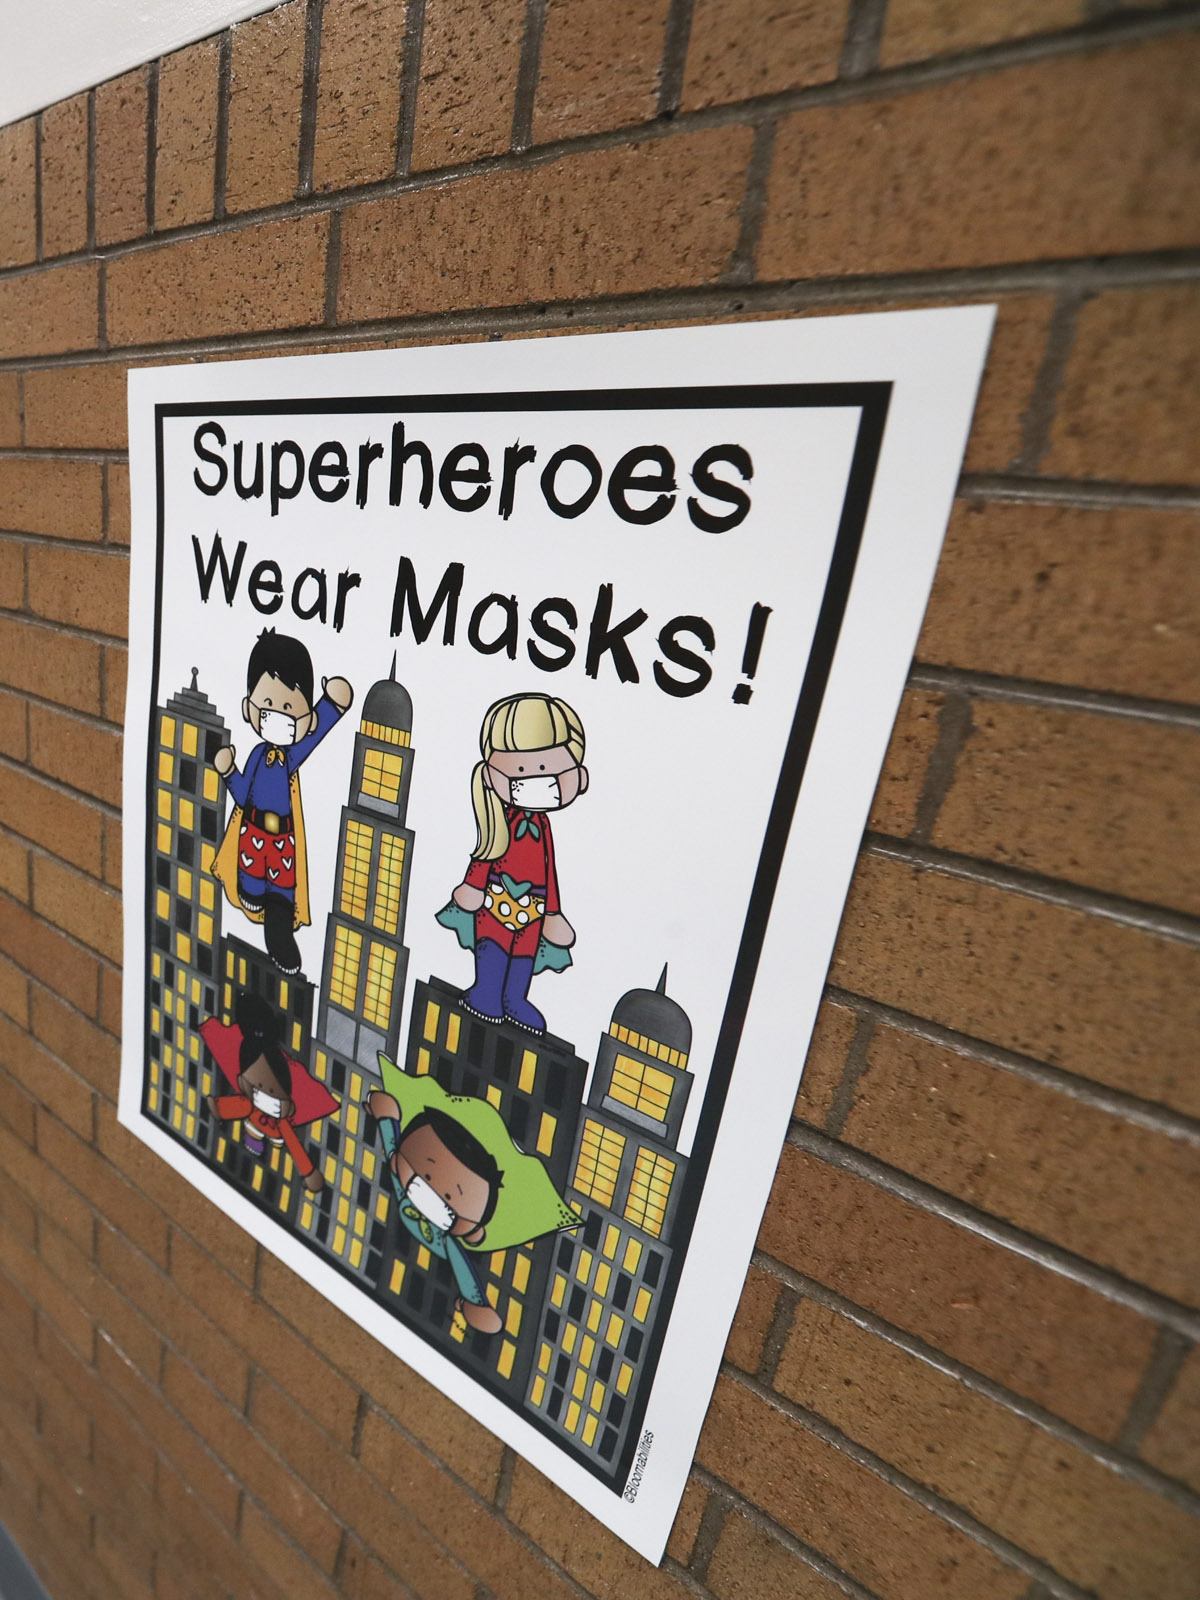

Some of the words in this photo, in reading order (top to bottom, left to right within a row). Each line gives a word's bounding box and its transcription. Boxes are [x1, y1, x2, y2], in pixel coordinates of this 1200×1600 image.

[193, 421, 754, 534] Superheroes
[191, 531, 362, 633] Wear
[390, 555, 774, 705] Masks!
